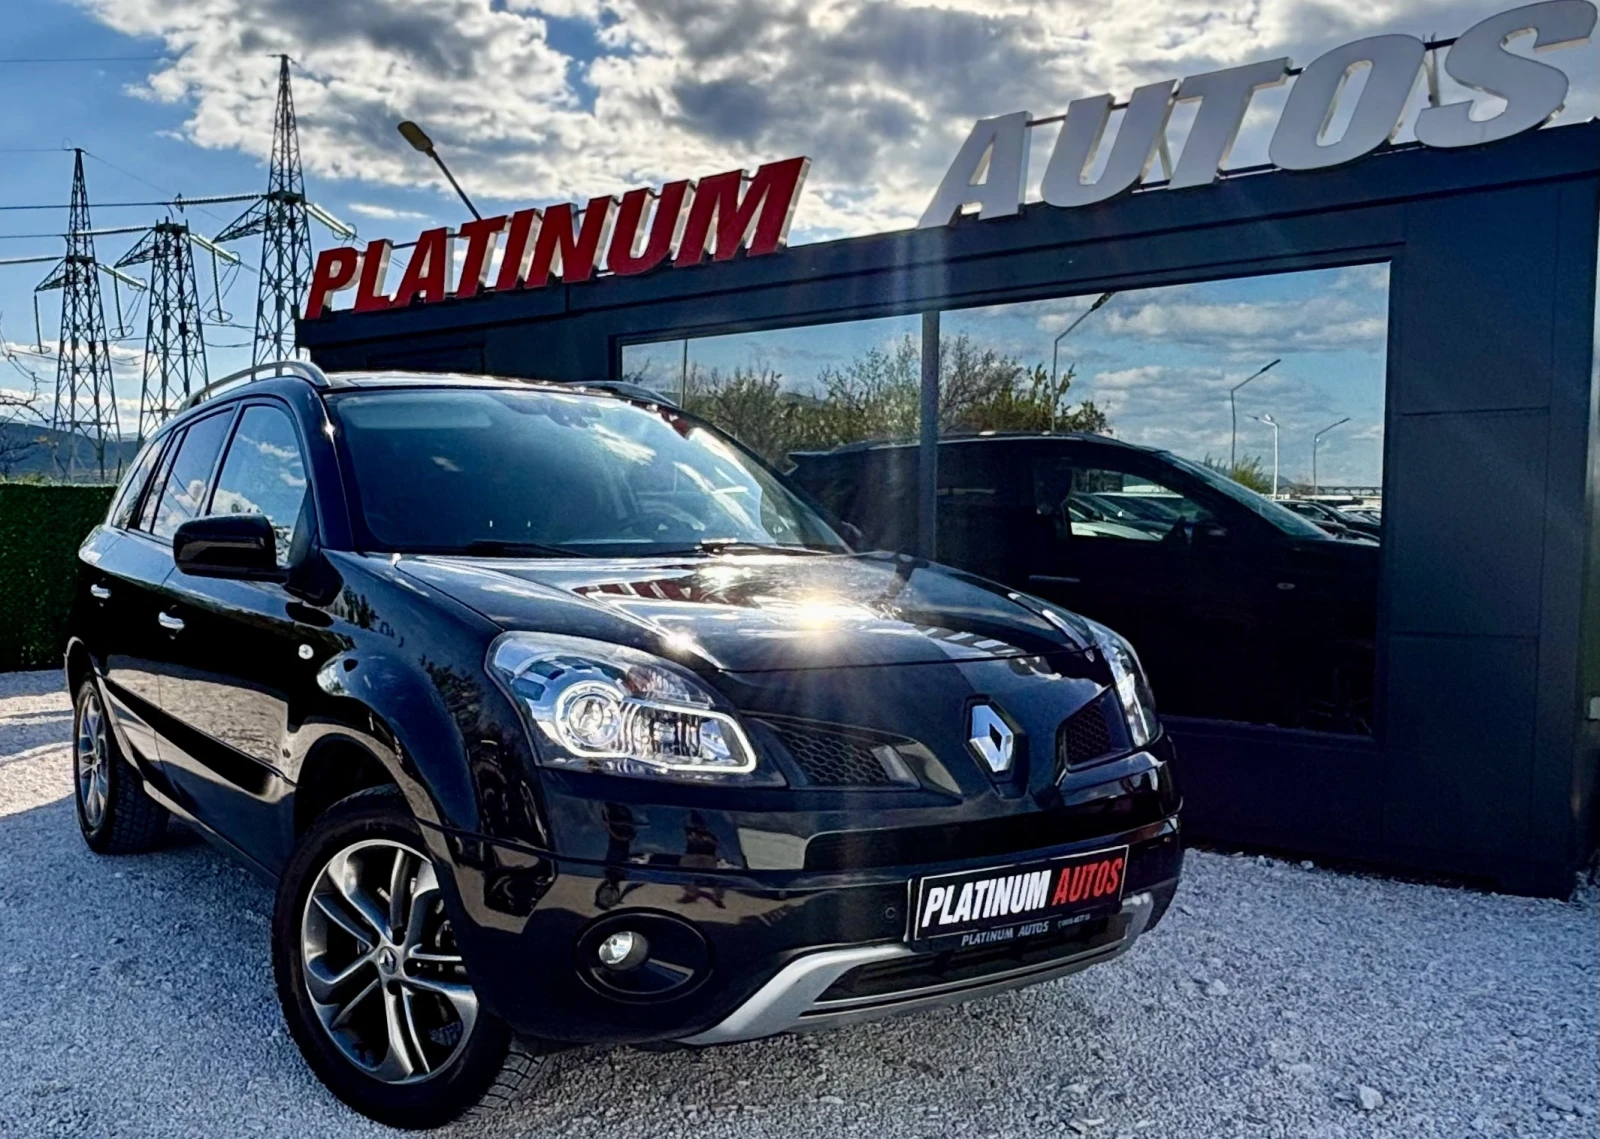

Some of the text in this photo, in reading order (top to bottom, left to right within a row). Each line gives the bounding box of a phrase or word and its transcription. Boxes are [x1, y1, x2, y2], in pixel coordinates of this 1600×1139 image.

[304, 0, 1598, 320] PLATINUM AUTOS
[921, 857, 1124, 928] PLATINUM AUTOS
[960, 927, 1014, 947] PLATINUM
[1017, 920, 1049, 938] AUTOS
